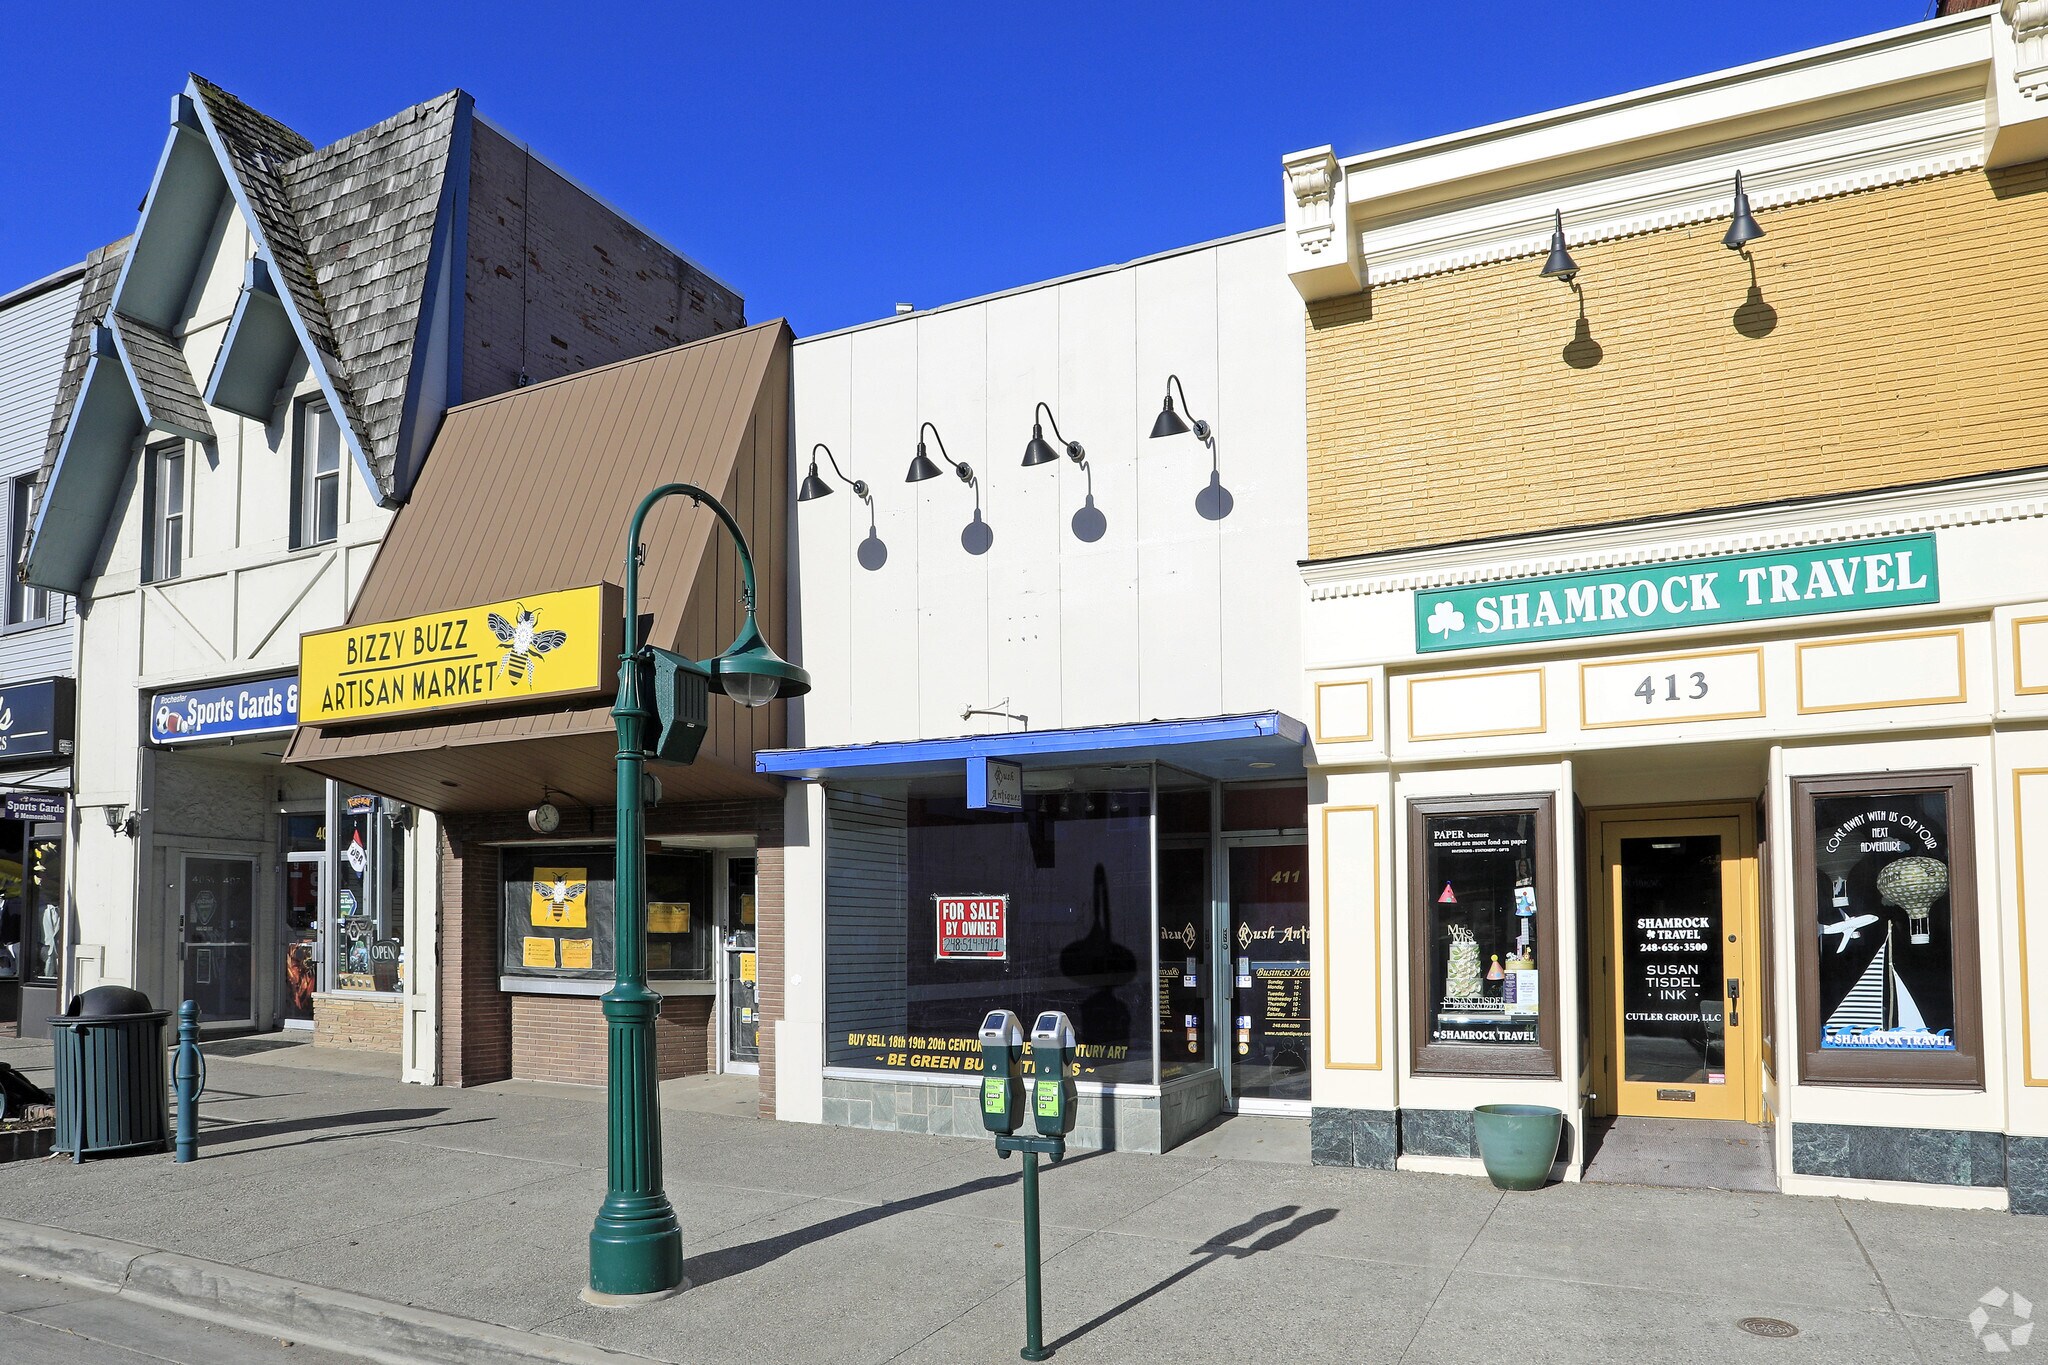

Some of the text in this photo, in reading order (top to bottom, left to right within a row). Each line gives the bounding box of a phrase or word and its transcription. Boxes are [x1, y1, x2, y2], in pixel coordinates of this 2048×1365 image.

[1475, 550, 1928, 634] SHAMROCK TRAVEL
[347, 619, 469, 665] BIZZY BUZZ
[321, 661, 498, 713] ARTISAN MARKET
[1634, 671, 1710, 705] 413
[161, 694, 188, 704] Rochester
[187, 684, 298, 732] Sports Cards &
[990, 789, 1020, 804] Antiques
[7, 800, 65, 814] Sports Cards
[20, 812, 56, 820] Memorabilia
[1434, 830, 1464, 840] PAPER
[1826, 810, 1938, 853] COME AWAY WITH US ON YOUR
[1872, 827, 1888, 838] NEXT
[1860, 840, 1902, 853] ADVENTURE
[1272, 870, 1300, 884] 411
[942, 902, 1000, 920] FOR SALE
[945, 921, 997, 936] BY OWNER
[1637, 917, 1710, 929] SHAMROCK
[1238, 924, 1310, 945] Rush Anti
[1657, 930, 1700, 940] TRAVEL
[372, 945, 396, 960] OPEN
[1256, 968, 1311, 976] Business Hou
[1646, 964, 1698, 975] SUSAN
[1645, 977, 1700, 988] TISDEL
[1660, 990, 1687, 1000] INK
[1625, 1012, 1721, 1022] CUTLER GROUP, LLC
[1440, 1030, 1536, 1040] SHAMROCK TRAVEL
[1835, 1034, 1952, 1046] SHAMROCK TRAVEL
[848, 1033, 1128, 1059] BUY SELL 18th 19th 20th CENTUR NTURY ART
[887, 1053, 907, 1066] BE
[910, 1054, 960, 1069] GREEN
[964, 1057, 984, 1071] BU
